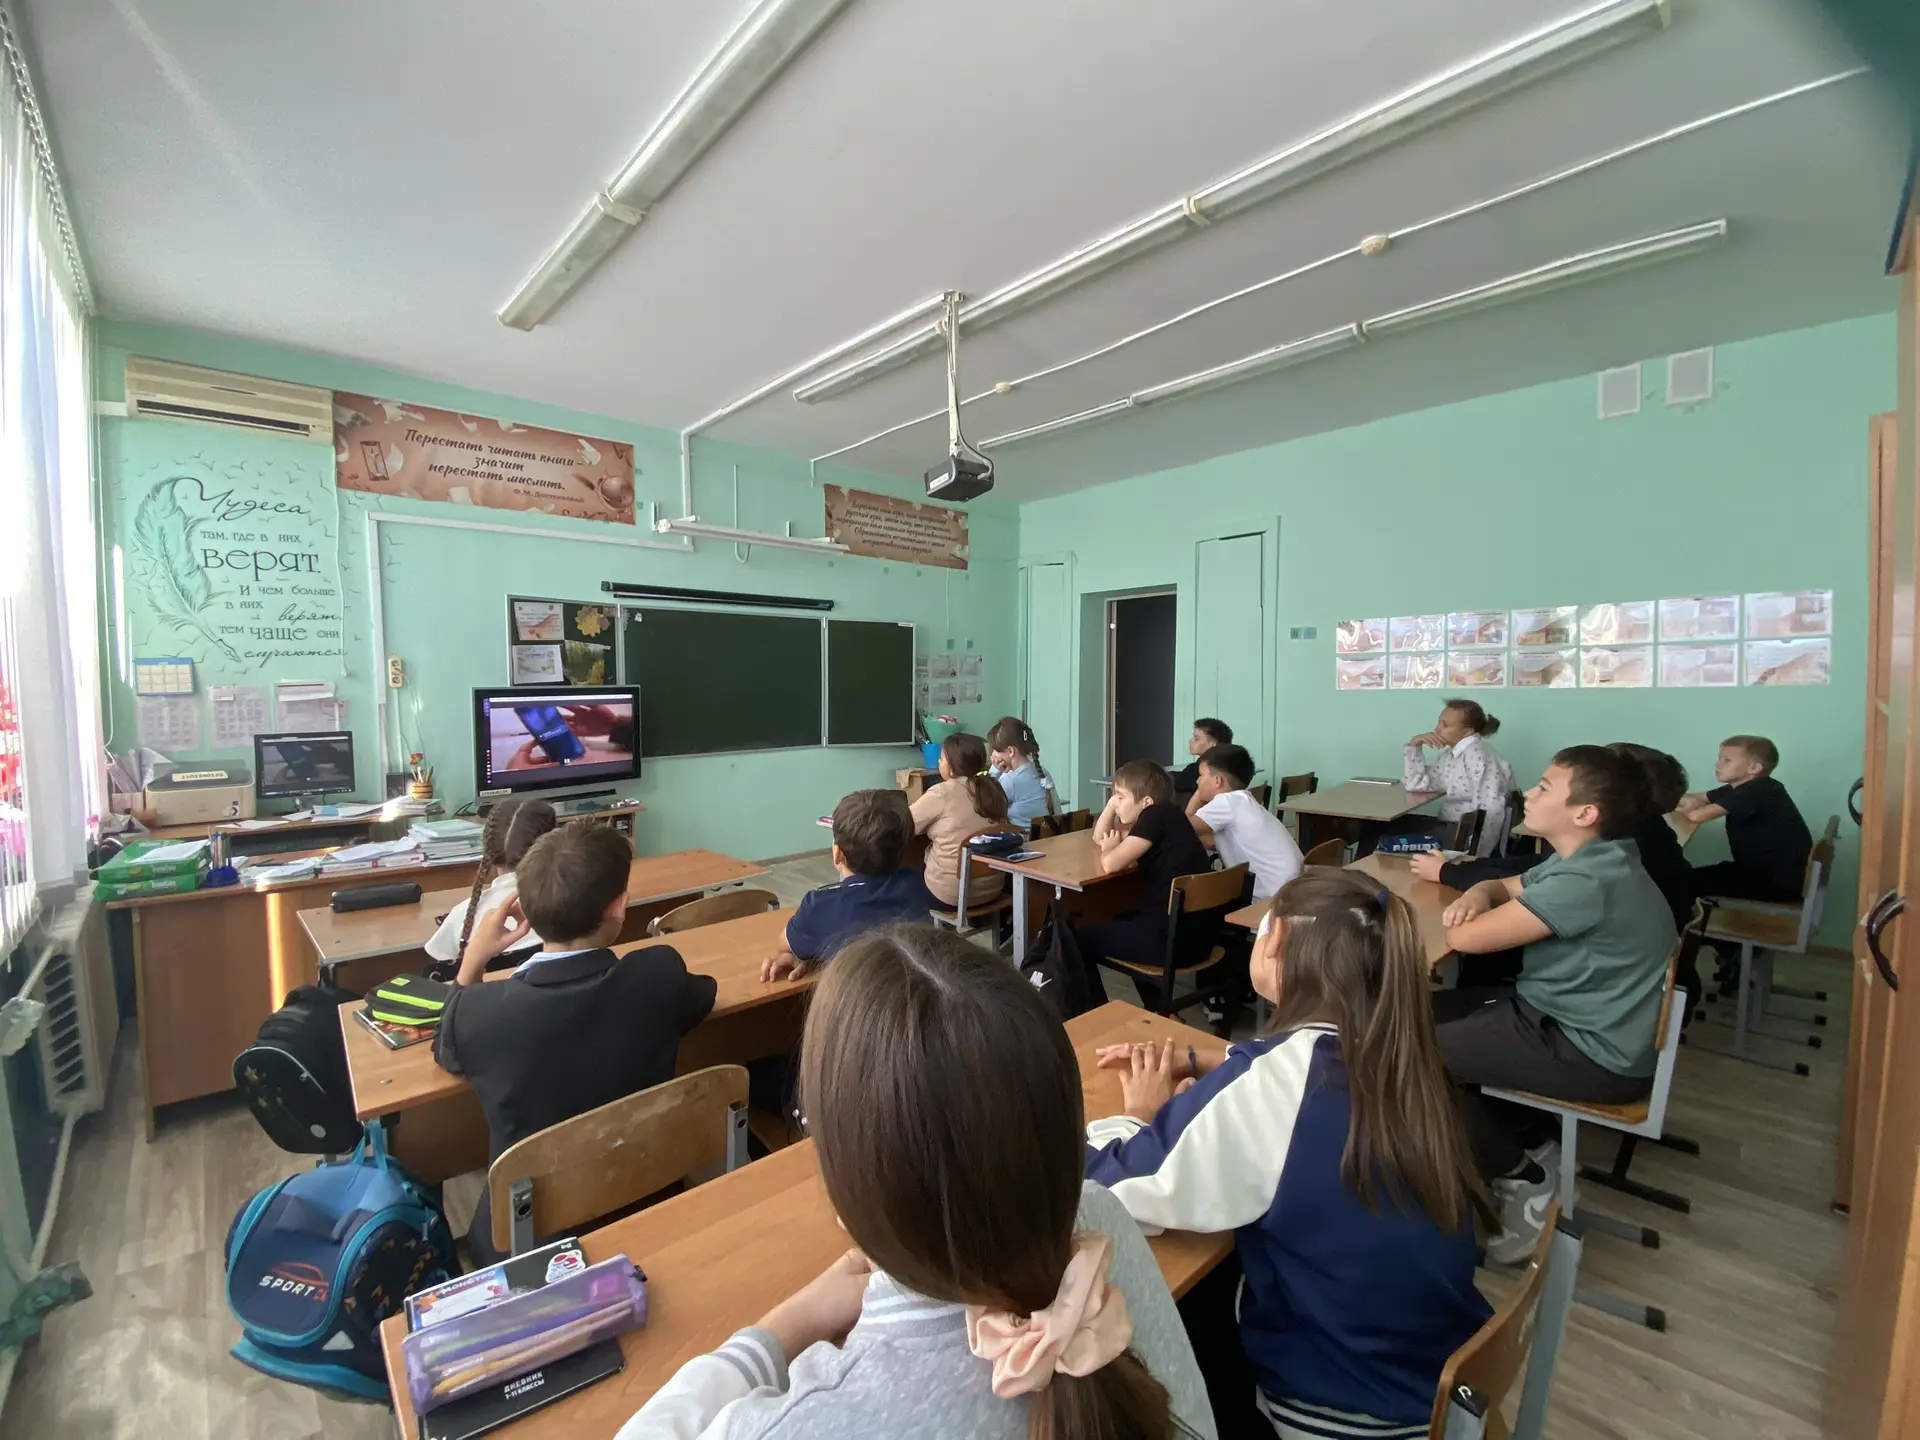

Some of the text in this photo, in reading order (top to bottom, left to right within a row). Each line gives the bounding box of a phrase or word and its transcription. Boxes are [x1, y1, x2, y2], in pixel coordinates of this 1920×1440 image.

[405, 429, 484, 452] Перестать
[487, 445, 537, 461] читать
[539, 454, 574, 467] книги
[472, 457, 524, 472] значит
[428, 463, 565, 491] перестать мыслить.
[173, 477, 311, 522] Чудеса
[231, 531, 256, 542] где
[260, 533, 269, 542] в
[278, 533, 302, 543] них
[200, 548, 321, 582] верят.
[239, 585, 336, 596] И чем больше
[225, 601, 235, 610] в
[240, 600, 264, 610] них
[218, 625, 341, 641] тем чаще они
[259, 1275, 316, 1297] SPORT
[504, 1371, 544, 1394] ДНЕВНИК
[518, 1378, 546, 1395] КЛАССЫ
